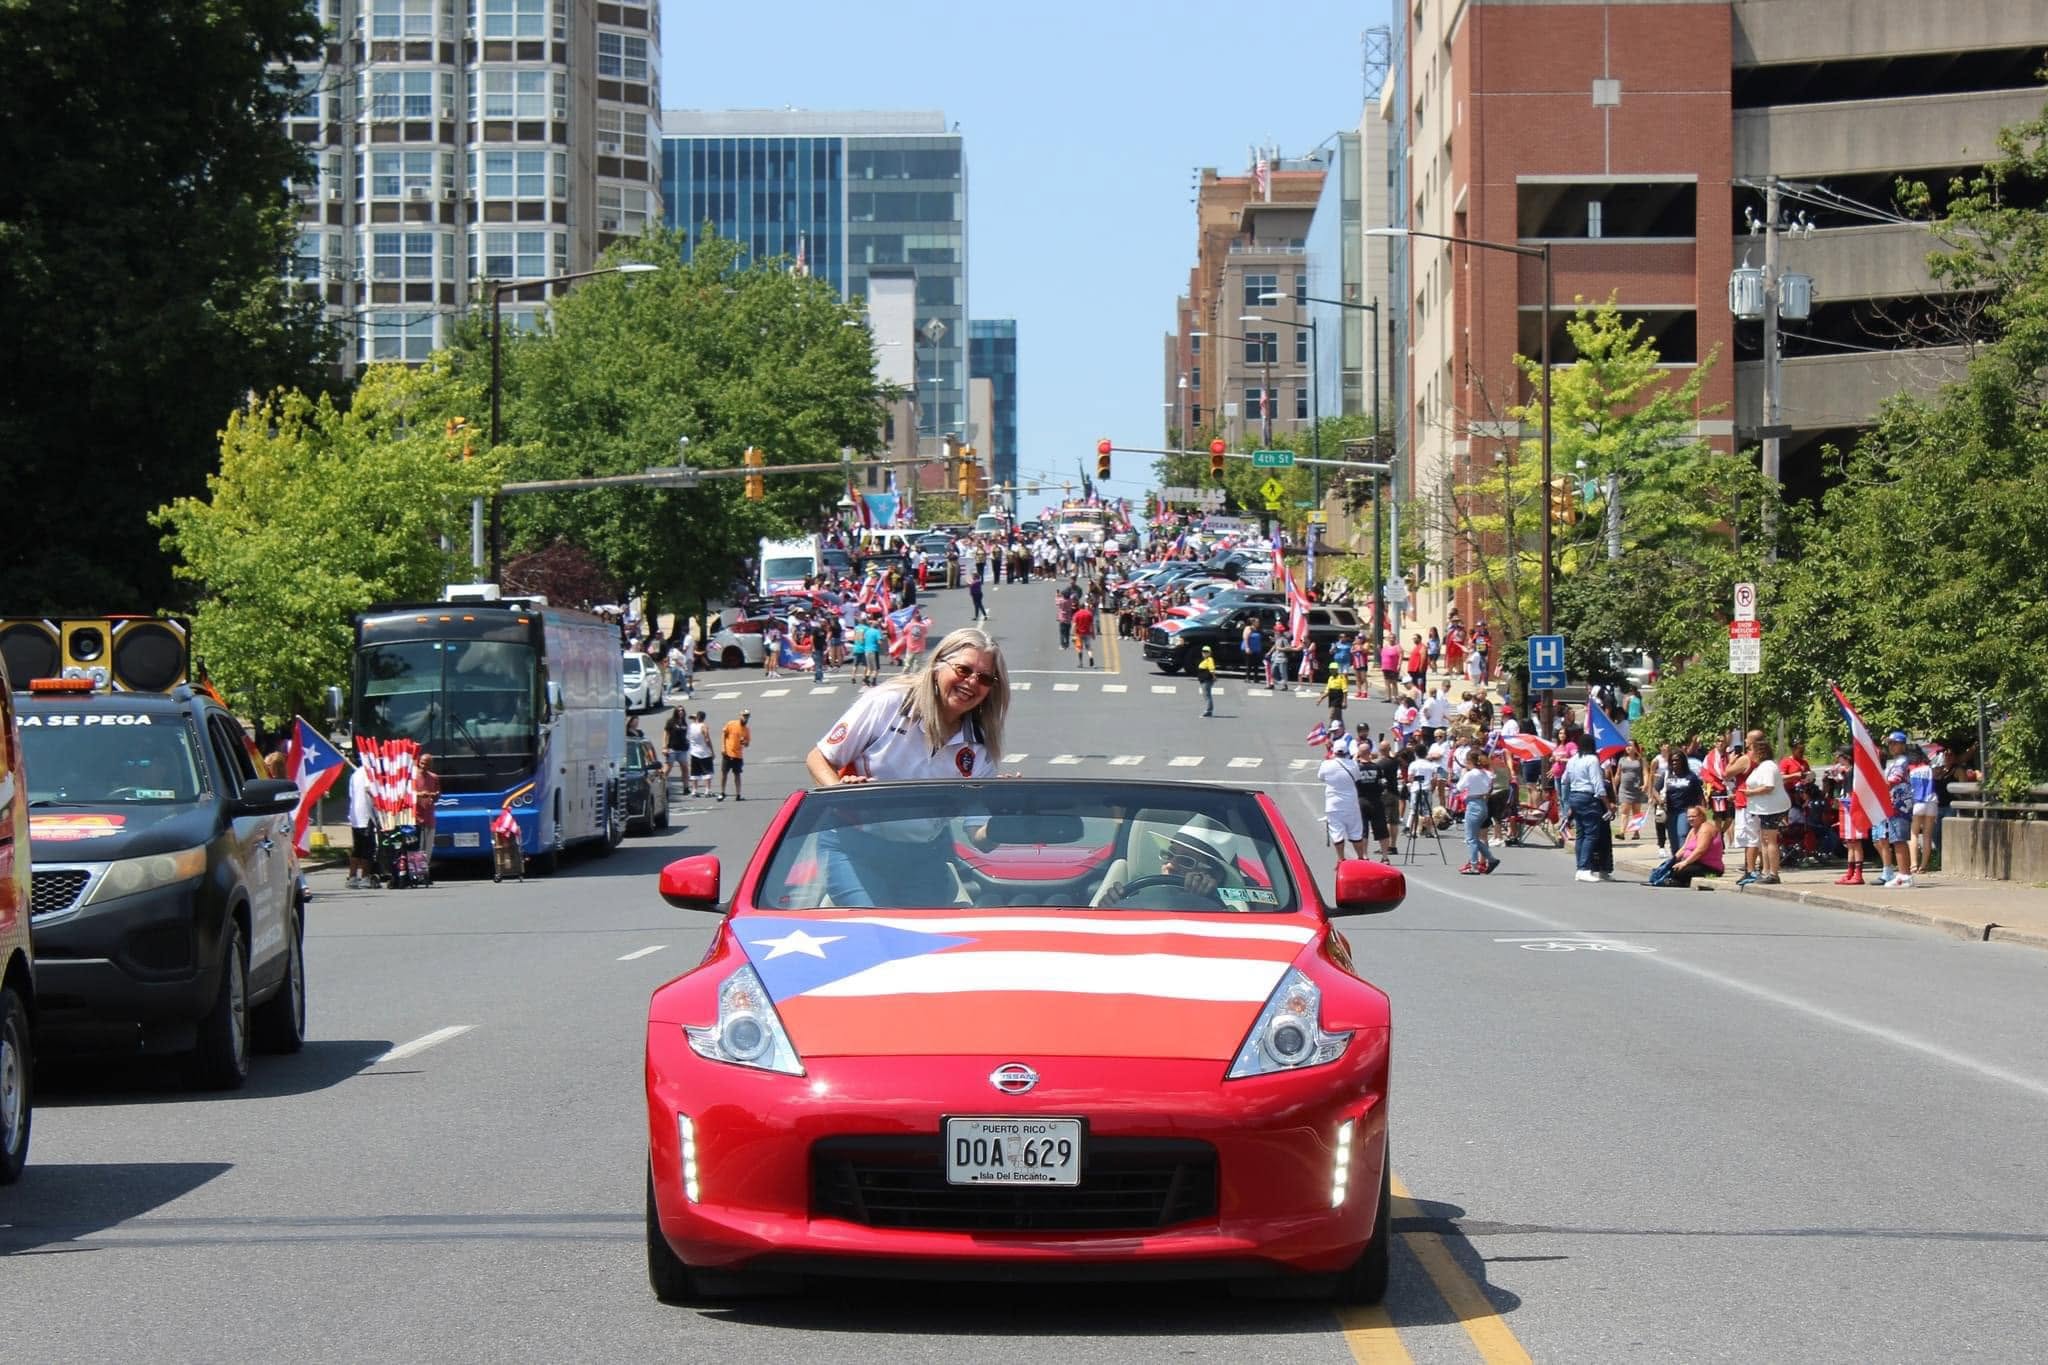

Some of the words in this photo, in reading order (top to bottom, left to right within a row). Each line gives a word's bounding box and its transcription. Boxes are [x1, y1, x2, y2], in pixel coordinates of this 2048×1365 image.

[1257, 453, 1275, 464] 4th
[1278, 453, 1289, 464] St
[1535, 641, 1556, 667] H
[47, 715, 79, 726] SE
[84, 714, 152, 726] PEGA
[982, 1125, 1019, 1134] PUERTO
[1023, 1125, 1046, 1134] RICO
[1023, 1138, 1072, 1168] 629
[979, 1172, 994, 1180] Isla
[996, 1172, 1011, 1180] Del
[1013, 1172, 1048, 1181] Encanto
